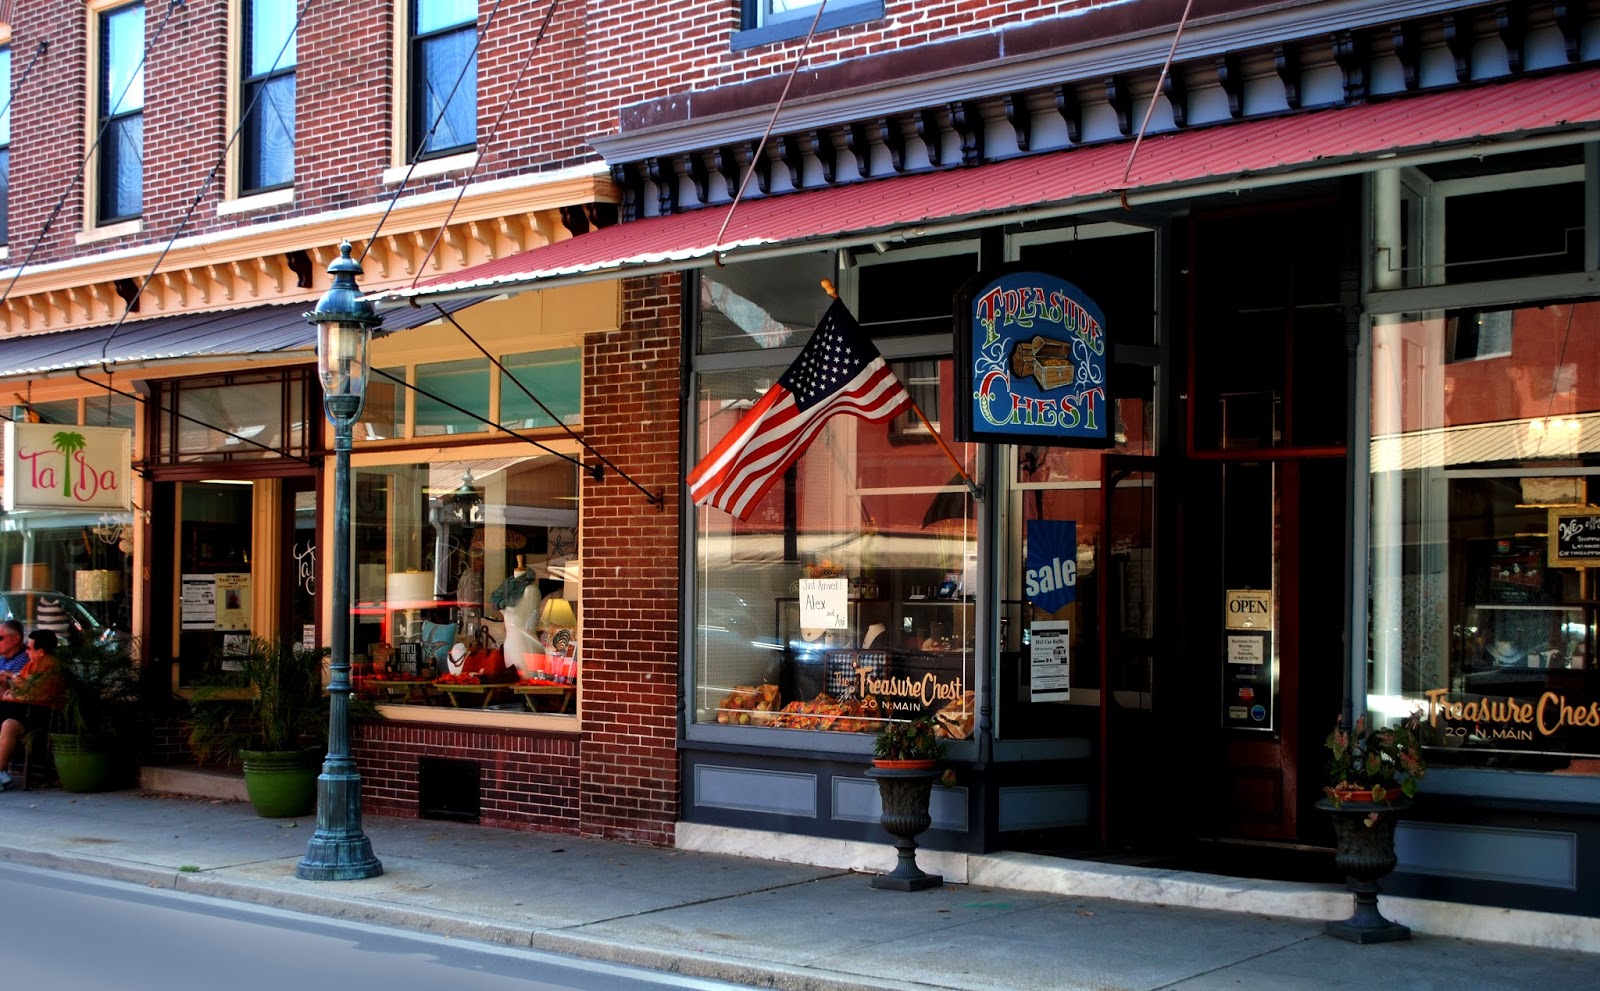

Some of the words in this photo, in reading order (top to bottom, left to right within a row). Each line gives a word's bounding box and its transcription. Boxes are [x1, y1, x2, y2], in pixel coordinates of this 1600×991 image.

[976, 286, 1105, 355] TREASURE
[974, 370, 1105, 430] CHEST
[18, 446, 66, 489] Ta
[73, 450, 118, 501] Da
[803, 580, 815, 590] Just
[1026, 557, 1076, 597] sale
[806, 594, 826, 610] Alex
[1230, 599, 1268, 613] OPEN
[856, 665, 921, 698] Treasure
[921, 672, 962, 707] Chest
[860, 699, 878, 709] 20
[1425, 687, 1534, 728] Treasure
[1536, 691, 1600, 736] Ches
[1445, 727, 1468, 737] 20
